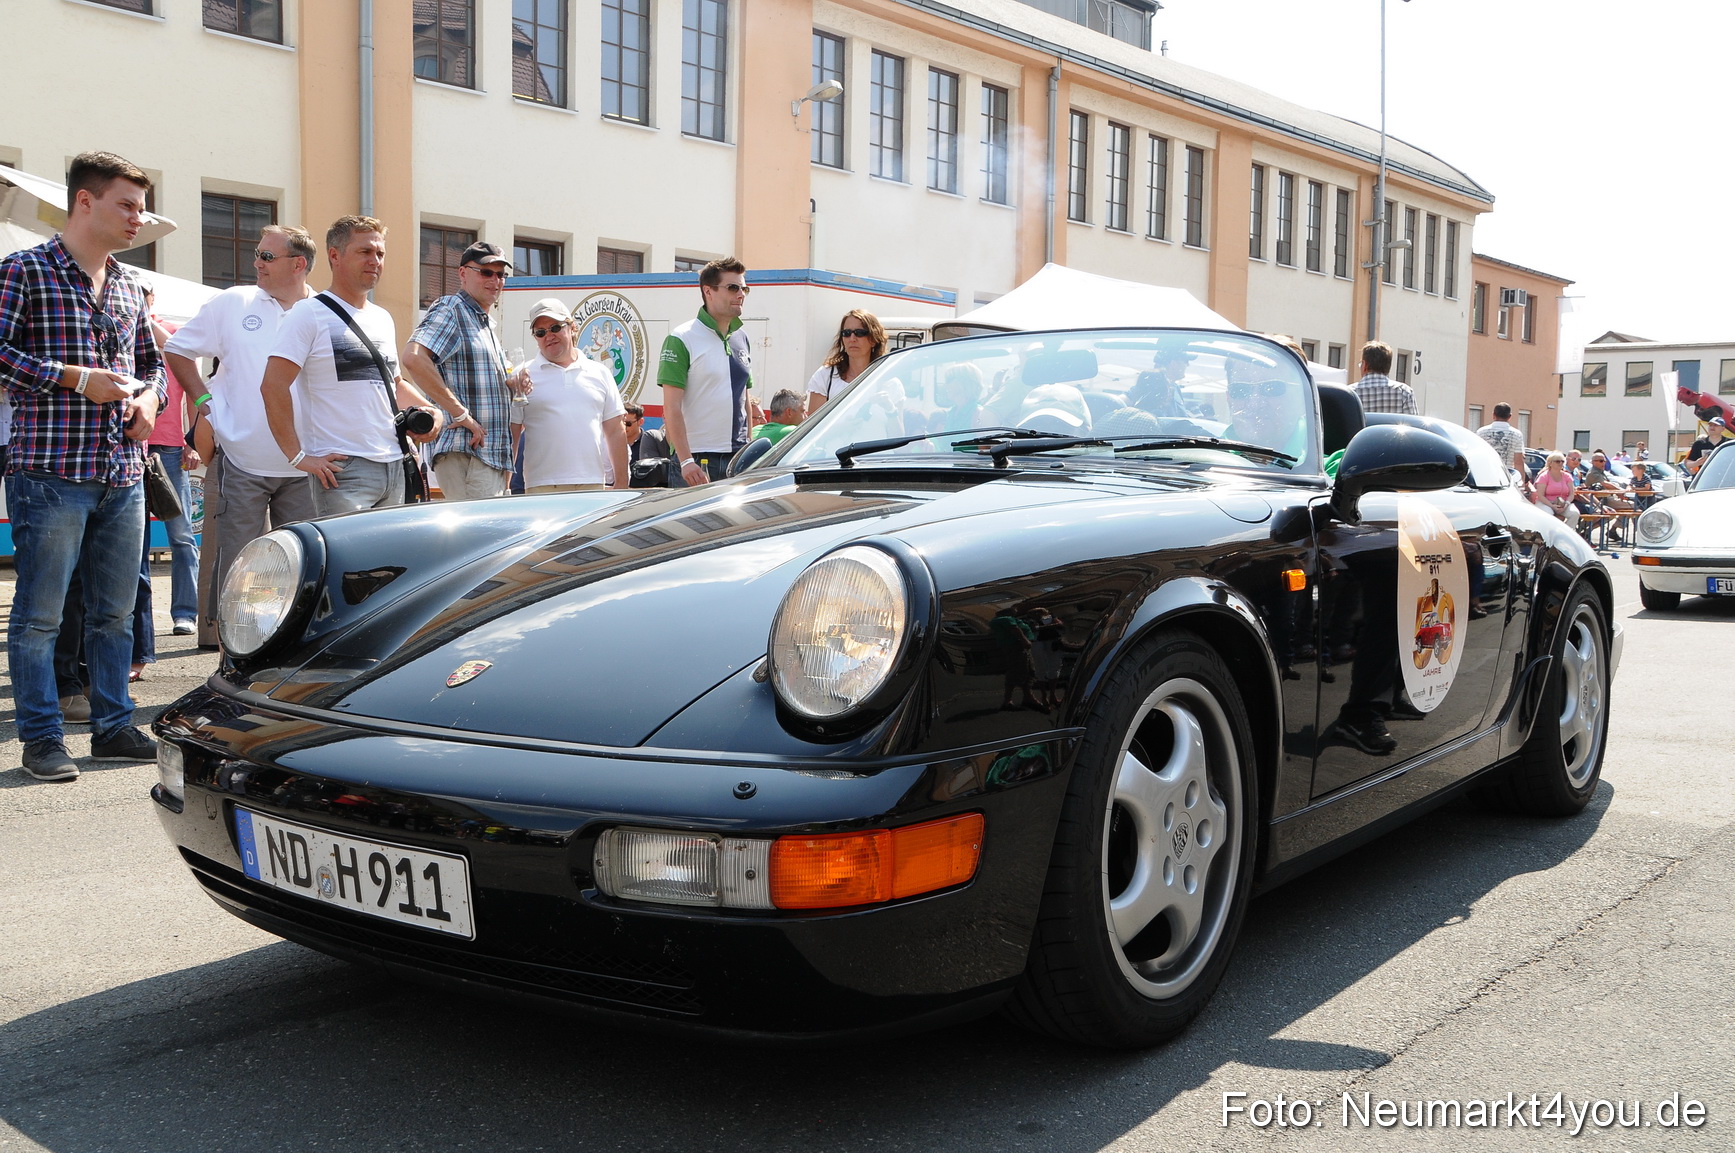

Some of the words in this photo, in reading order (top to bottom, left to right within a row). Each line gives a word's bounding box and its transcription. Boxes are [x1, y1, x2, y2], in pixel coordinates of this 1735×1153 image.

[574, 310, 587, 325] St.
[584, 297, 615, 316] Georgen
[614, 298, 633, 324] Bräu
[1413, 350, 1422, 375] 5
[1414, 553, 1452, 565] PORSCHE
[1429, 564, 1440, 574] 911
[1422, 666, 1442, 678] JAHRE
[246, 850, 254, 865] D
[265, 826, 312, 887] ND
